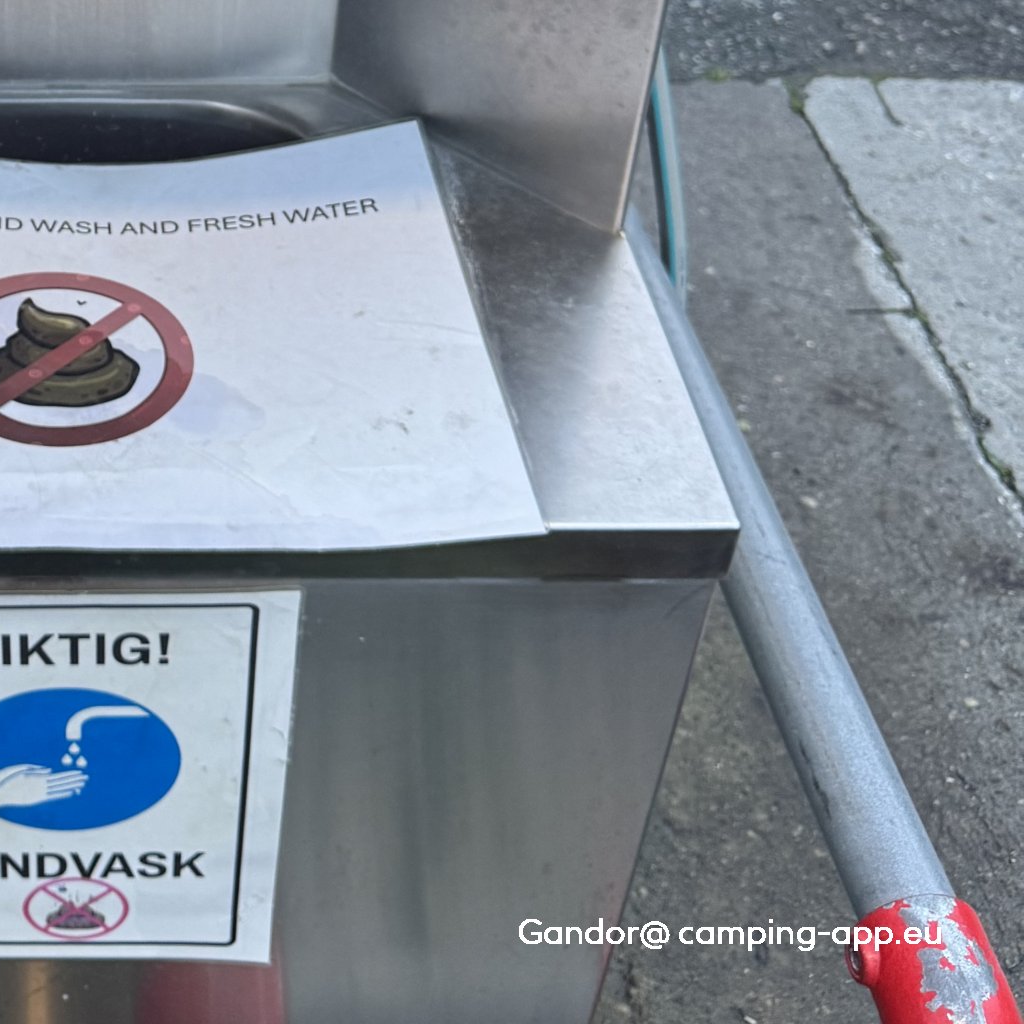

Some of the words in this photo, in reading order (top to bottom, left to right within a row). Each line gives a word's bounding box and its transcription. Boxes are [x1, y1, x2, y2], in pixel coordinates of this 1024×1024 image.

[30, 219, 112, 235] WASH
[120, 221, 179, 235] AND
[188, 212, 276, 232] FRESH
[282, 198, 378, 224] WATER
